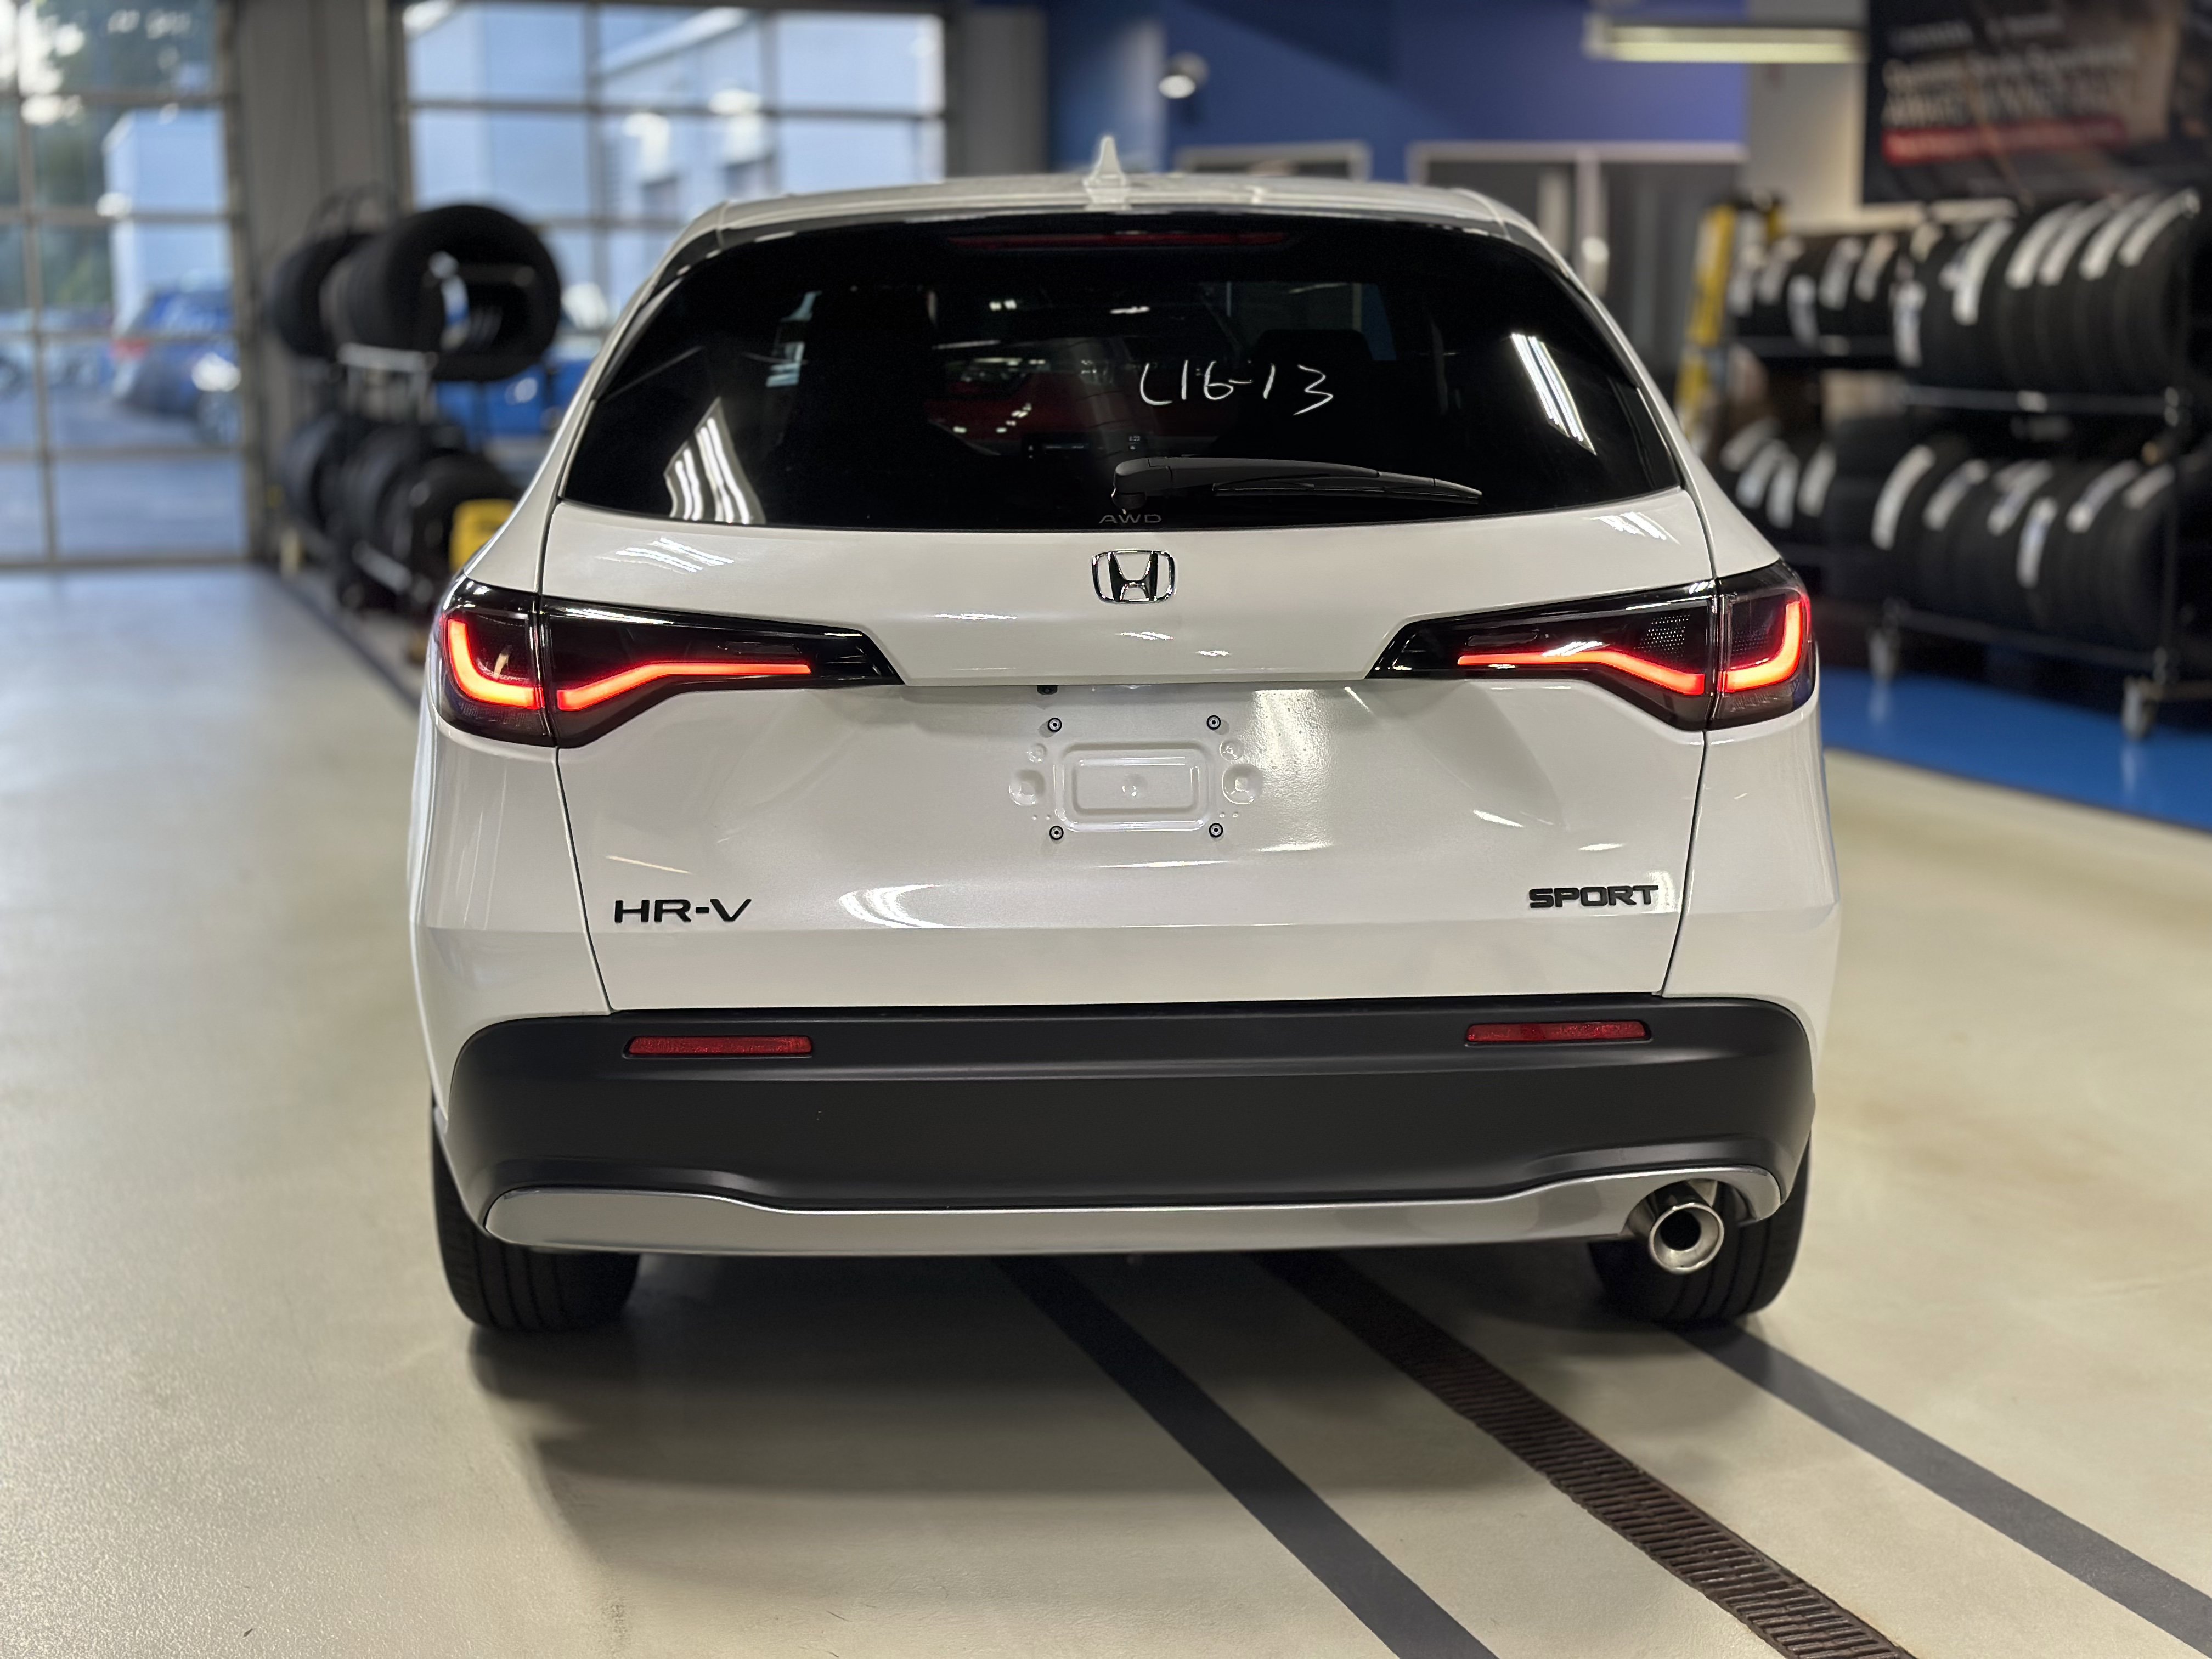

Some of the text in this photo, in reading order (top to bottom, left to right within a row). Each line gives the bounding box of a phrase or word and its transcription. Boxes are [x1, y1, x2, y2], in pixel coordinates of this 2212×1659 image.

[1098, 514, 1163, 524] AWD
[1529, 885, 1659, 909] SPORT
[614, 899, 752, 923] HR-V
